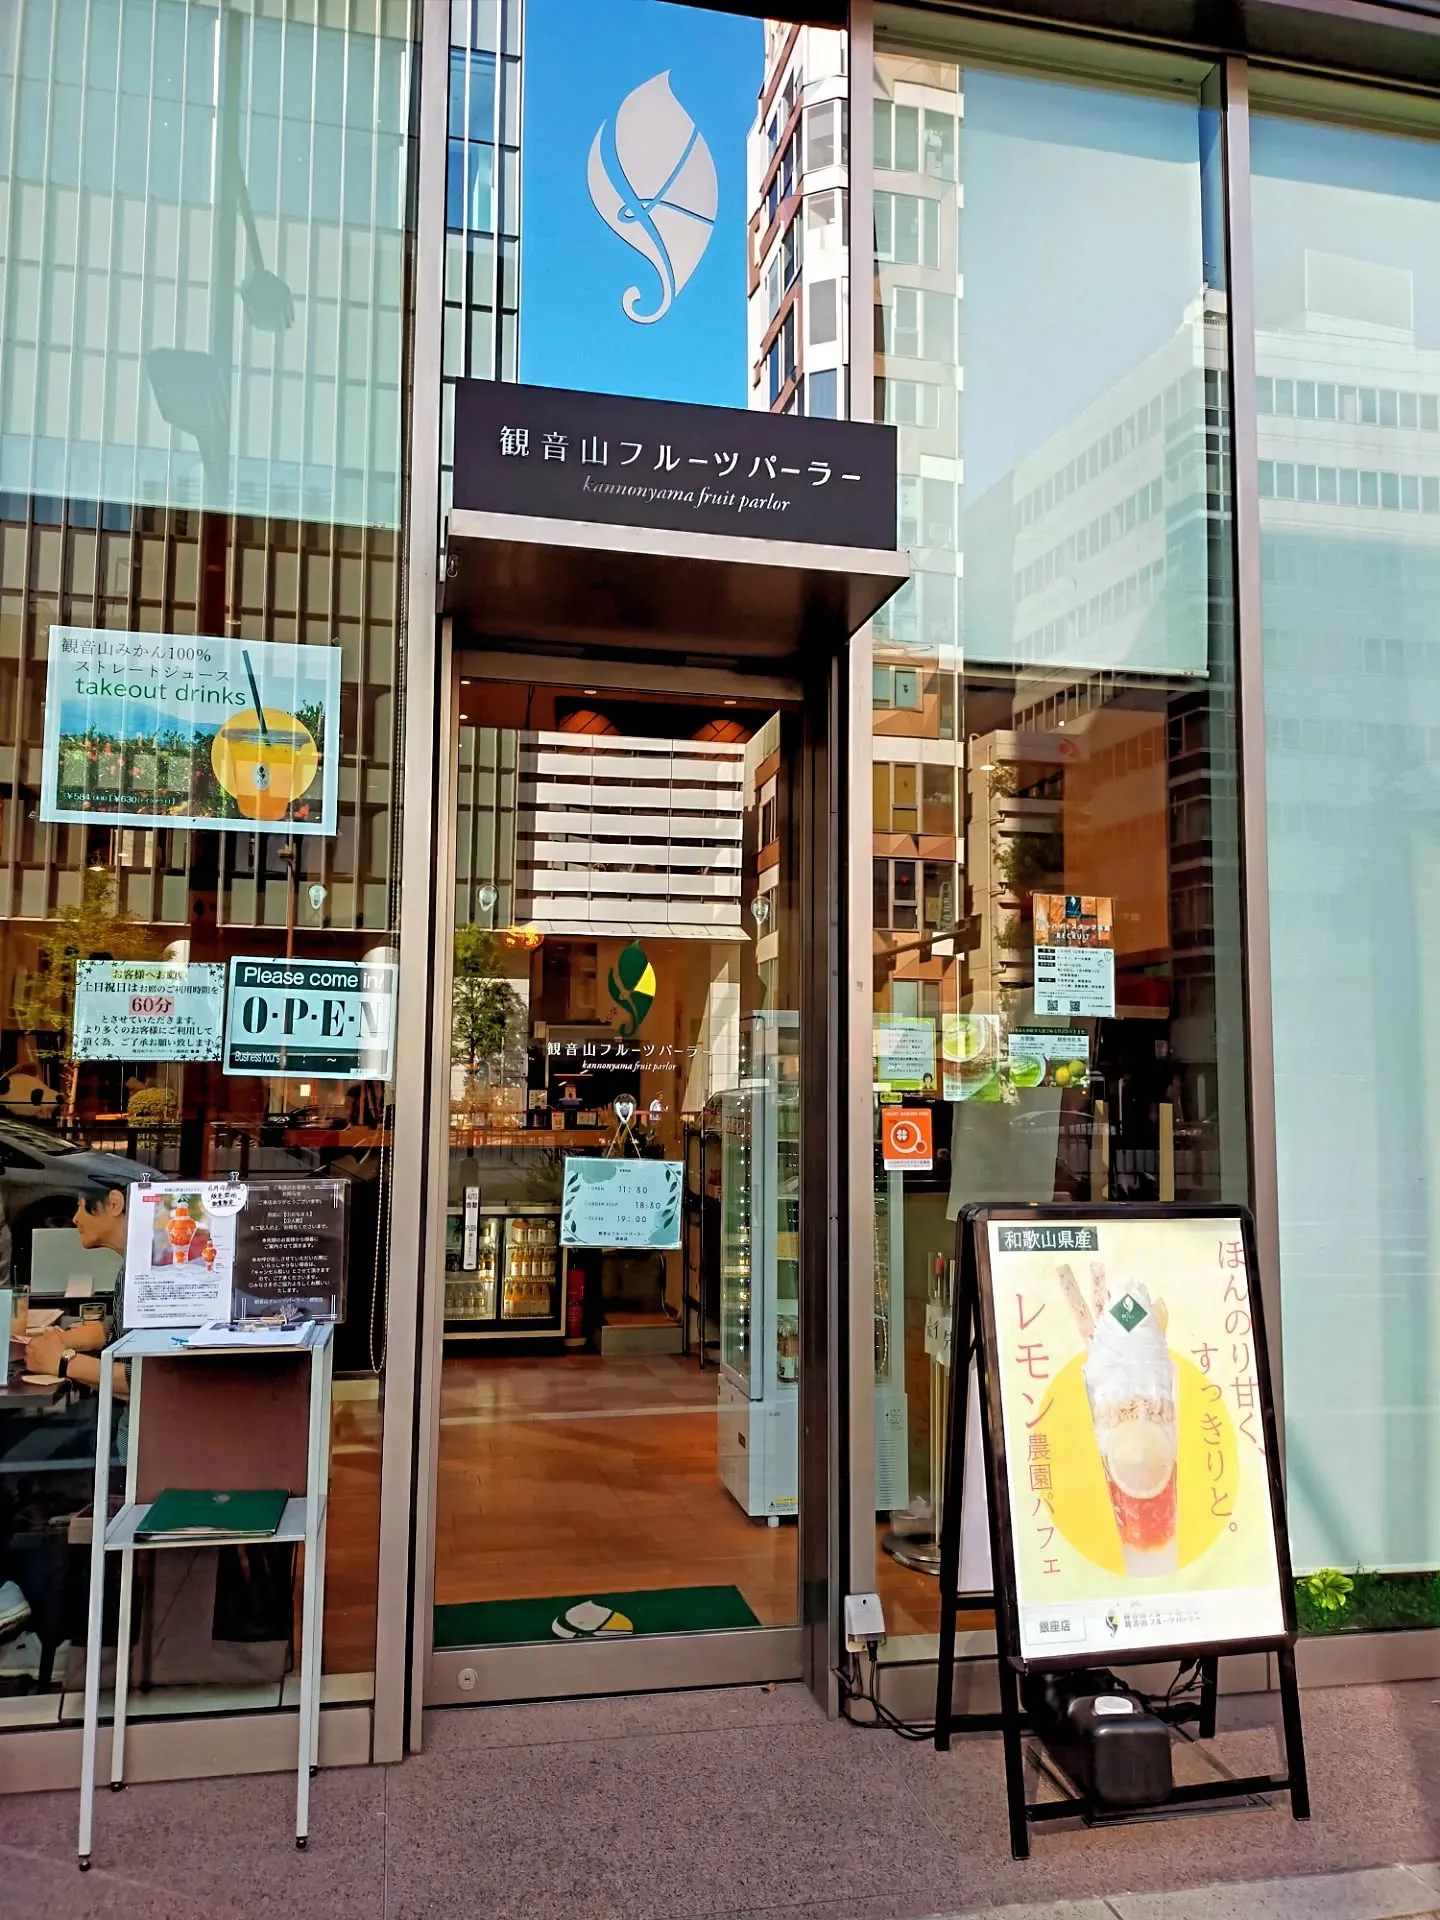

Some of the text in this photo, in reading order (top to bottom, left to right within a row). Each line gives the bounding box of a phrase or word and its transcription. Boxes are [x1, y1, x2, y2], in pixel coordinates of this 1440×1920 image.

[500, 425, 861, 487] 観音山フルーツパーラー
[583, 475, 790, 512] kannonyama fruit parlor
[61, 637, 211, 663] 観音山みかん100%
[75, 659, 230, 683] ストレートジュース
[75, 677, 246, 707] takeout drinks
[1056, 932, 1090, 941] RECRUIT
[244, 967, 304, 985] Please
[309, 973, 359, 988] come
[132, 996, 172, 1013] 60分
[84, 1025, 213, 1036] より多くのお客様にご利用して
[102, 1015, 196, 1026] とさせていただきます。
[547, 1041, 711, 1058] 観音山フルーツパーラー
[582, 1060, 677, 1073] kannonyama fruit parlor
[1004, 1229, 1093, 1249] 和歌山県産
[1217, 1239, 1267, 1457] ほんのり甘く、
[1190, 1342, 1238, 1534] すっきりと。
[1039, 1620, 1071, 1633] 銀座店
